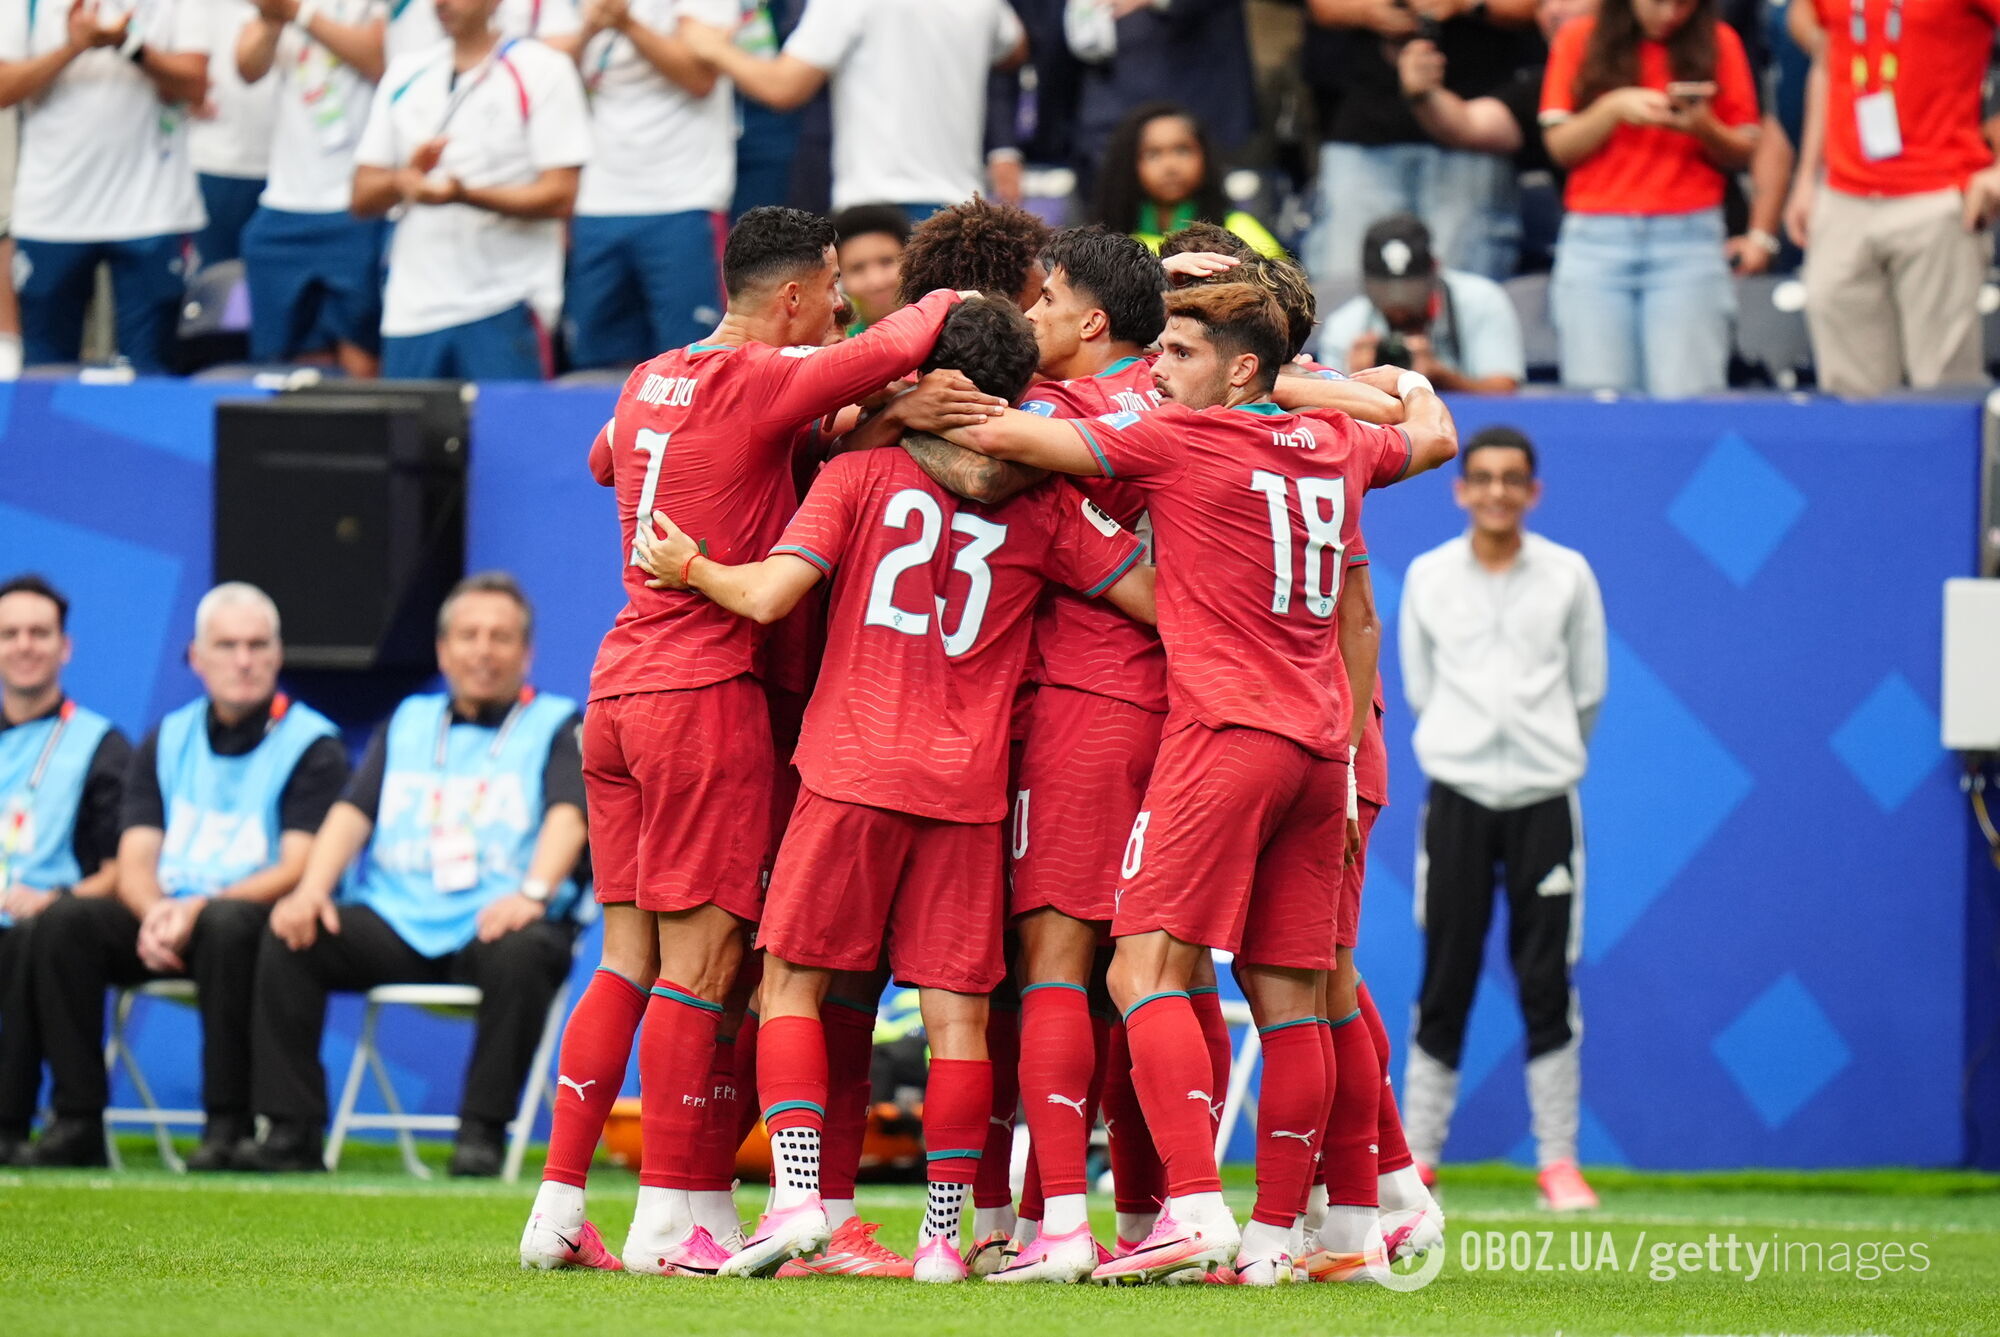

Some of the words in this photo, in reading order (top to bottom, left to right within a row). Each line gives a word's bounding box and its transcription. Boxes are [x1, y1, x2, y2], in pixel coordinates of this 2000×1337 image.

[630, 428, 672, 566] 7
[1251, 469, 1346, 619] 18
[864, 488, 1008, 657] 23
